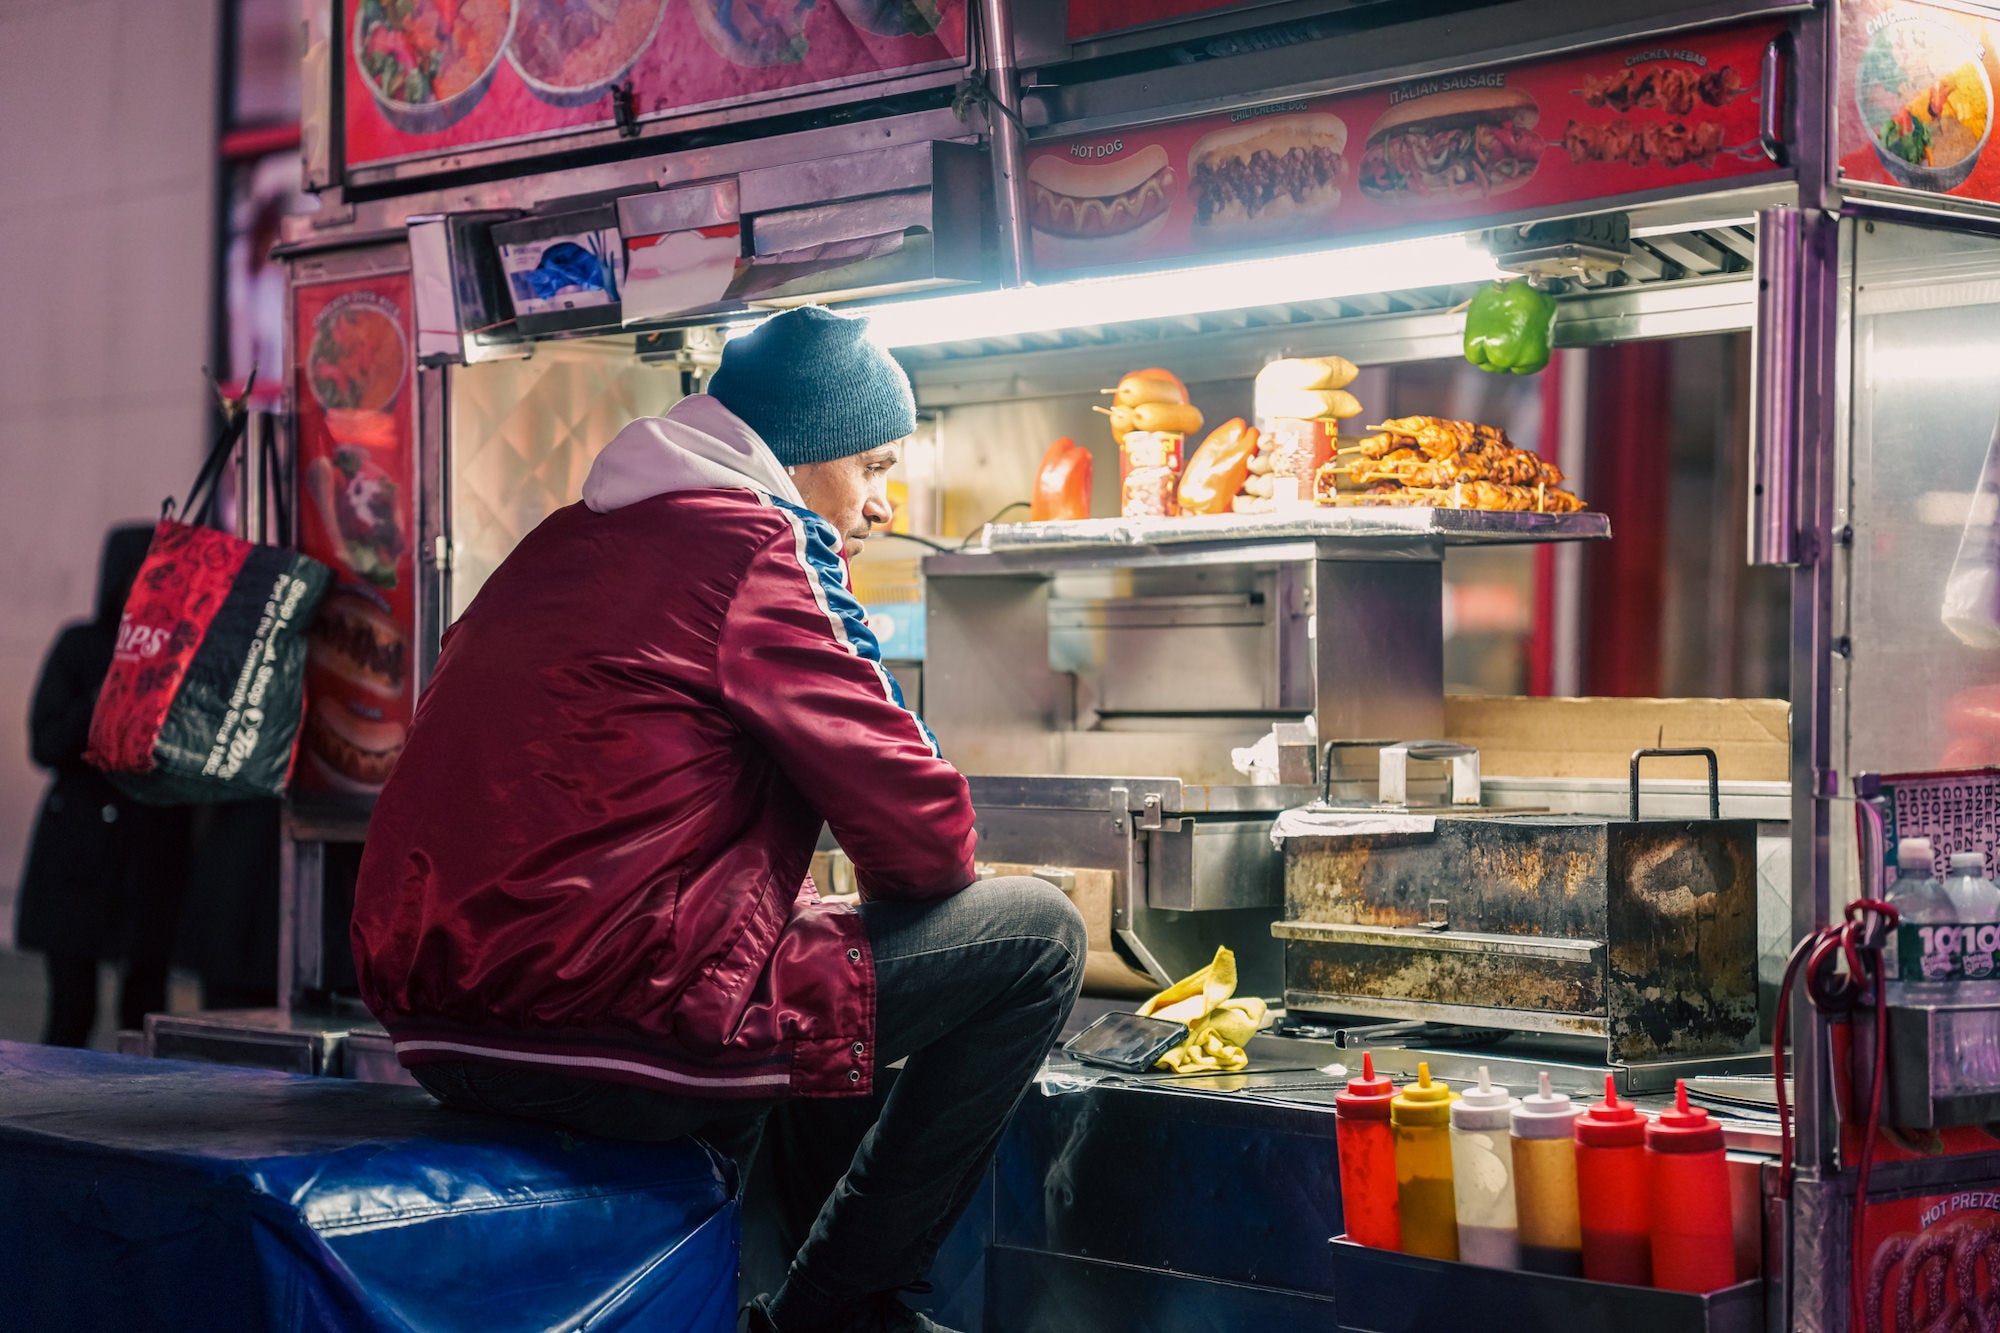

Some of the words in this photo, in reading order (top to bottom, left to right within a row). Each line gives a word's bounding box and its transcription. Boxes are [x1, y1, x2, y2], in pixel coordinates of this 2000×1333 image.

[1625, 50, 1669, 66] CHICKEN
[1673, 50, 1707, 66] KEBAB
[1389, 80, 1439, 105] ITALIAN
[1442, 73, 1505, 92] SAUSAGE
[1230, 106, 1253, 122] CHILI
[1254, 102, 1286, 115] CHEESE
[1288, 101, 1308, 112] DOG
[1069, 144, 1094, 158] HOT
[1097, 139, 1123, 158] DOG
[264, 600, 276, 618] of
[280, 578, 308, 620] Shop
[256, 616, 272, 637] the
[228, 638, 264, 710] Community
[247, 665, 274, 707] Shop
[215, 709, 241, 744] Since
[1897, 789, 1909, 839] CHILI
[1909, 788, 1920, 828] HOT
[1921, 787, 1930, 838] CHILI
[1931, 787, 1941, 827] HOT
[1942, 786, 1952, 836] CHILI
[1975, 785, 1983, 843] KNISH
[1984, 784, 1993, 834] BEEF
[1920, 1200, 1948, 1230] HOT
